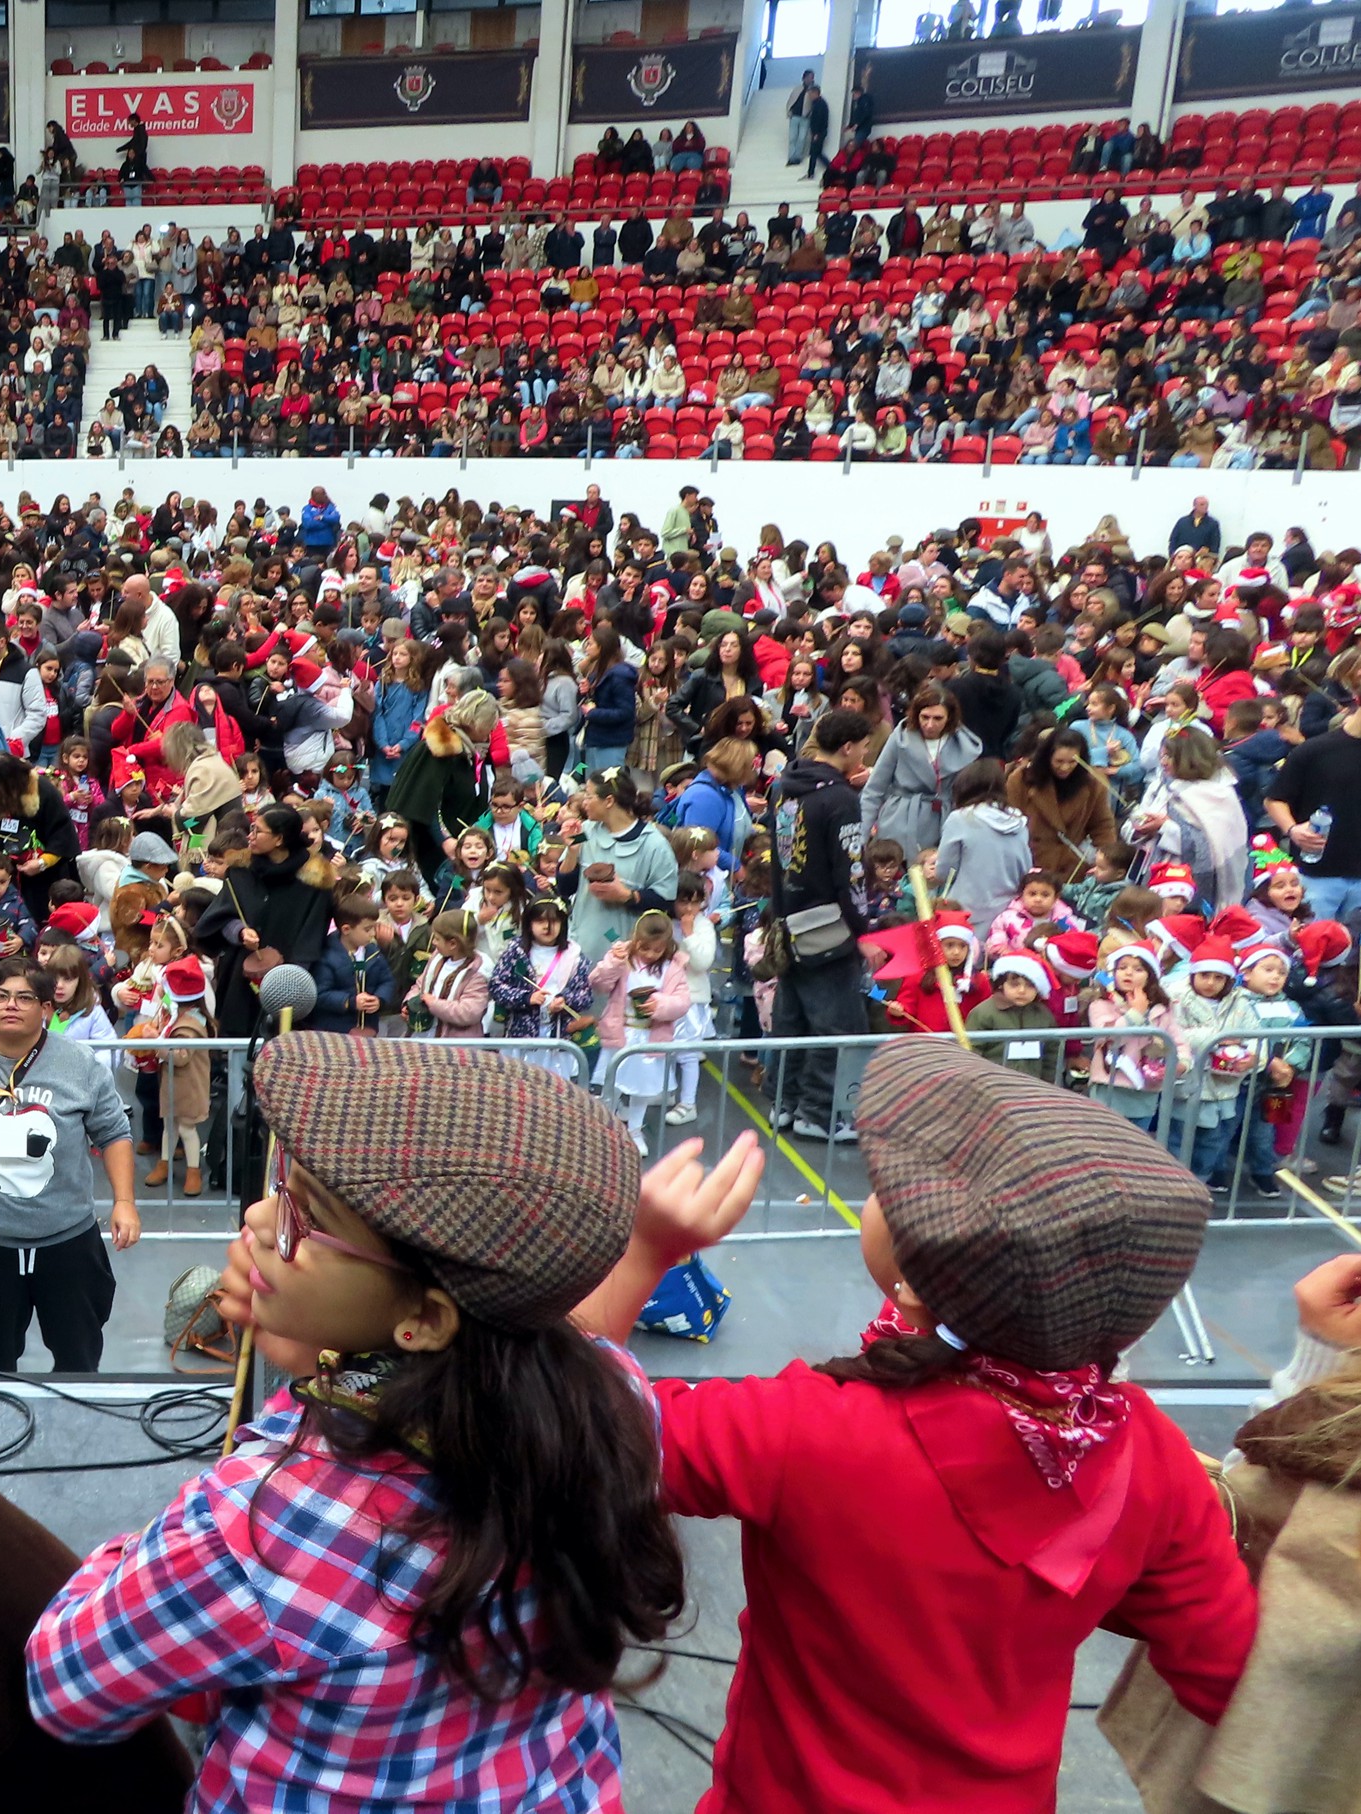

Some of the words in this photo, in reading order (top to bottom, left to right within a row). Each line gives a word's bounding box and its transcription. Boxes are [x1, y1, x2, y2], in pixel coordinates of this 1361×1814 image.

[1281, 43, 1361, 70] COLISE
[946, 74, 1035, 97] COLISEU
[71, 91, 200, 117] ELVAS
[71, 119, 110, 133] Cidade
[113, 116, 199, 132] Mumental
[23, 1048, 39, 1068] Canon
